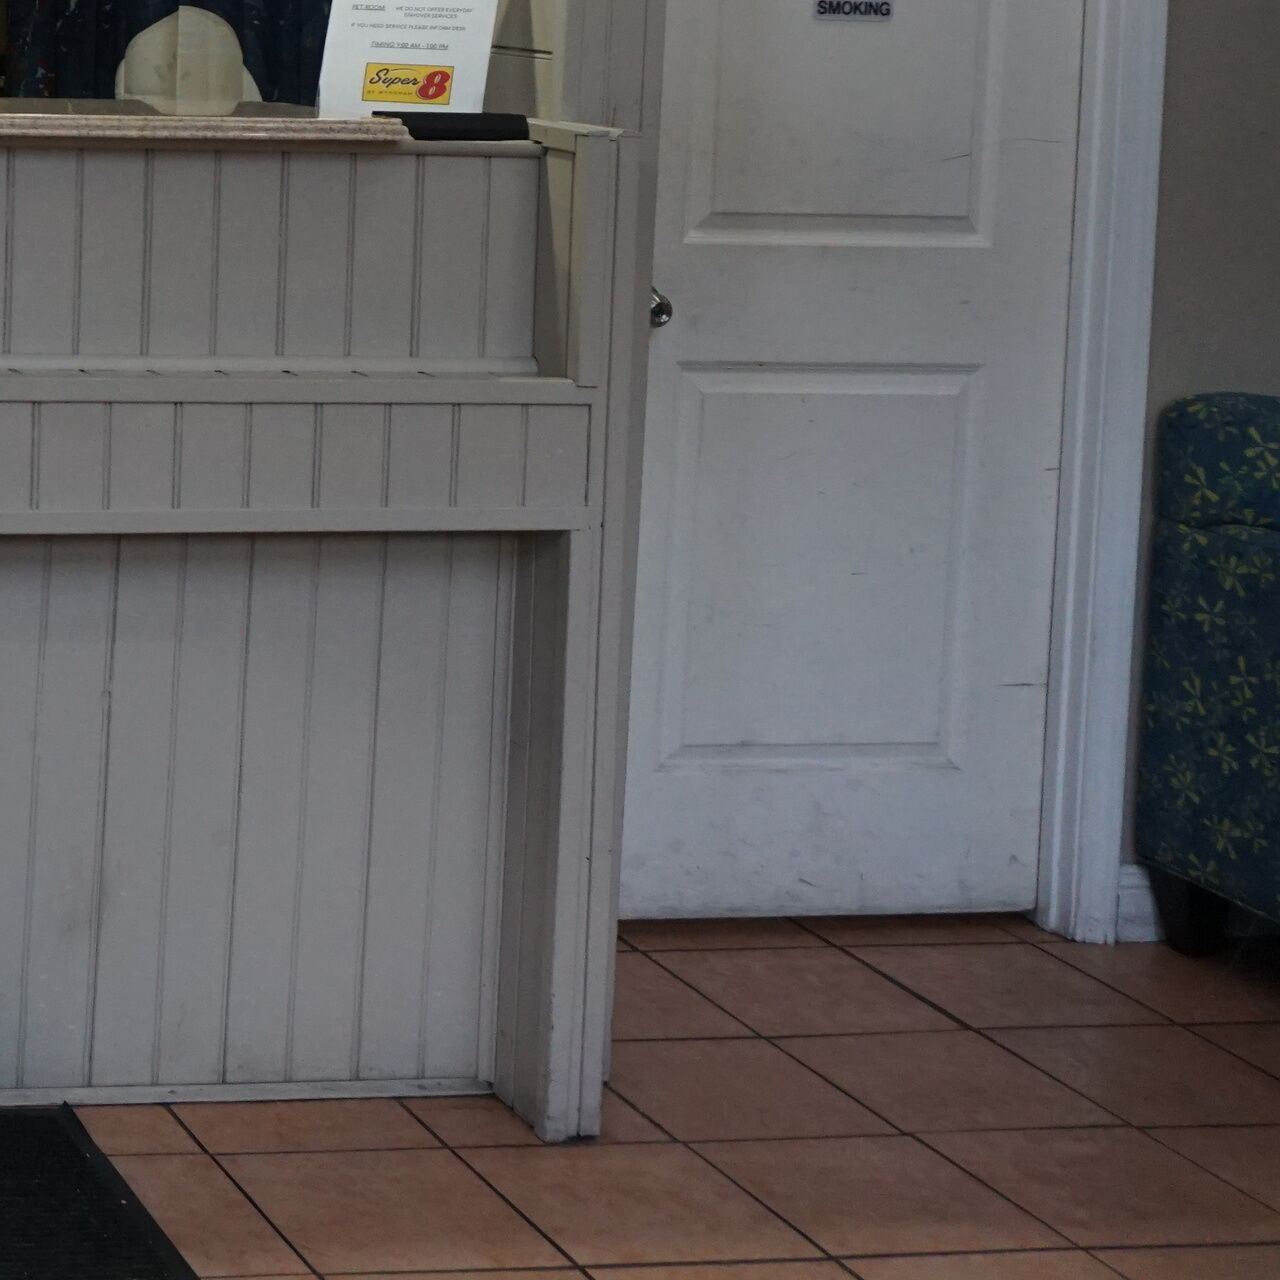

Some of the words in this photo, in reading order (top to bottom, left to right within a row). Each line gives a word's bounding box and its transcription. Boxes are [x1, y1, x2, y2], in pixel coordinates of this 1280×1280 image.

[817, 0, 890, 16] SMOKING
[369, 68, 419, 88] Super
[416, 71, 450, 100] 8
